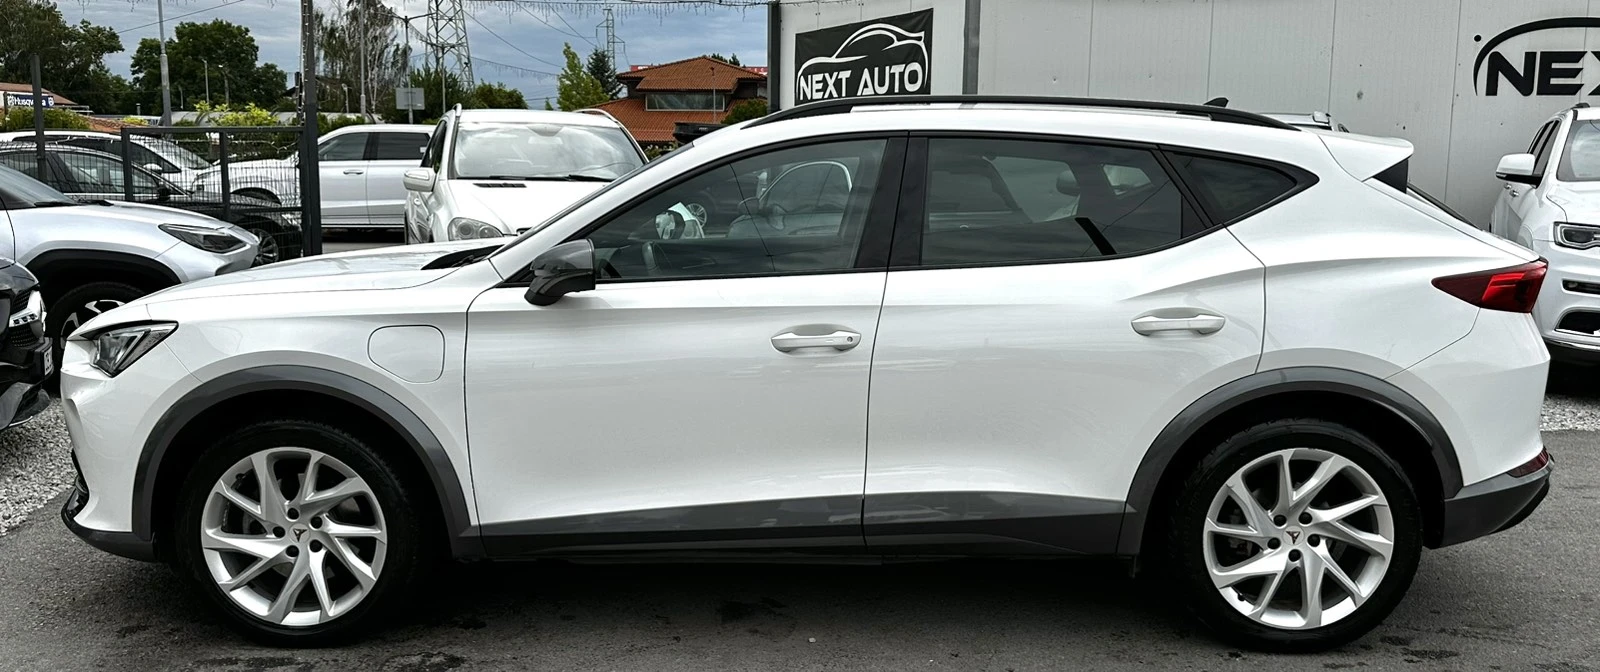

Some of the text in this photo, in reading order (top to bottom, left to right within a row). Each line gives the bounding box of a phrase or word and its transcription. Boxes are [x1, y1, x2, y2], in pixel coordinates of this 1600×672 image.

[800, 62, 922, 100] NEXT AUTO
[1485, 51, 1600, 96] NE
